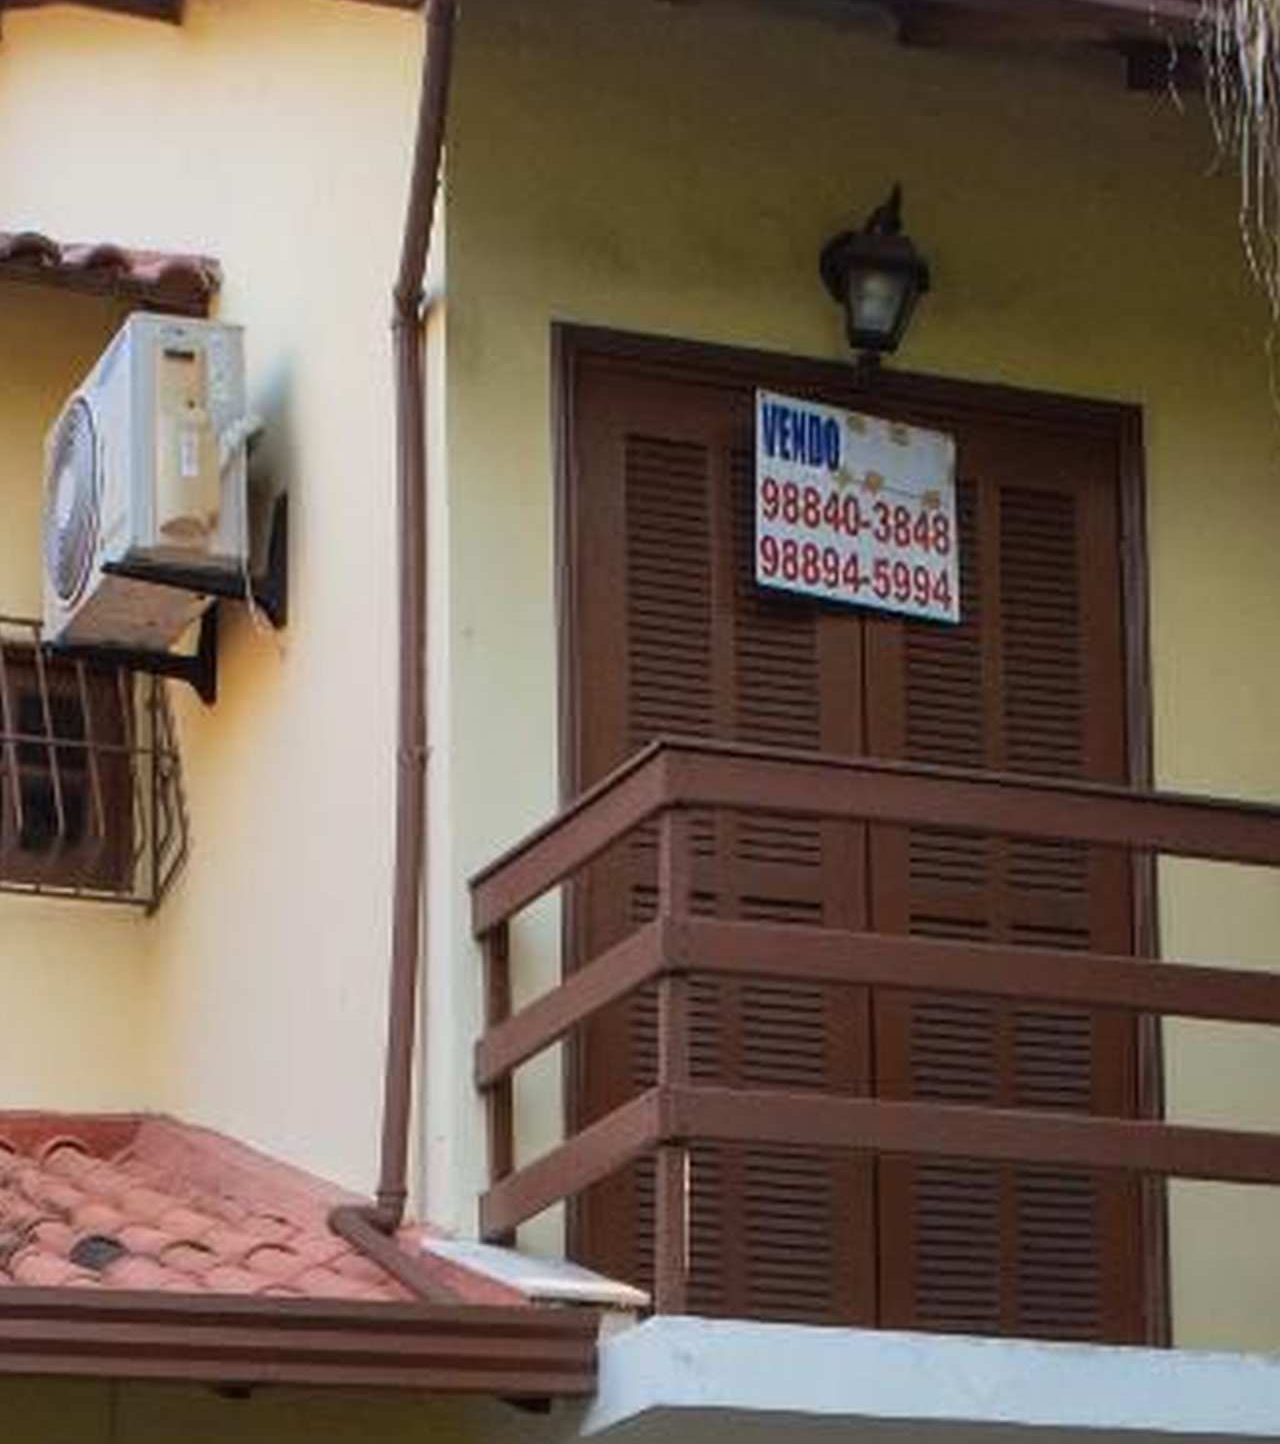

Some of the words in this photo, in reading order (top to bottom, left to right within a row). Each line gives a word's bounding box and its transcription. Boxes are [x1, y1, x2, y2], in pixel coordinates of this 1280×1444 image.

[762, 403, 840, 471] VENDO
[761, 478, 950, 555] 98840-3848
[759, 535, 953, 610] 98894-5994
